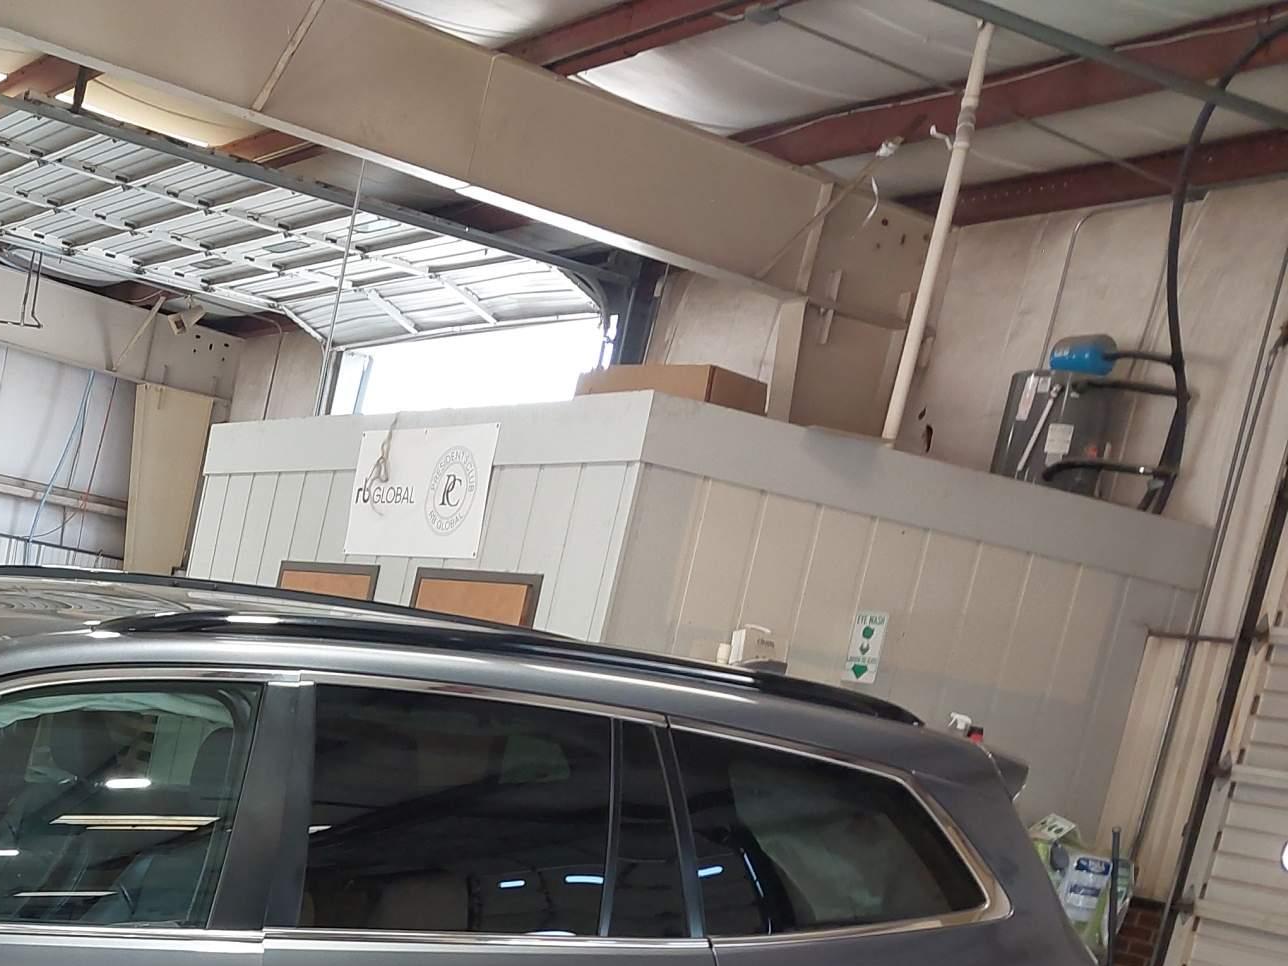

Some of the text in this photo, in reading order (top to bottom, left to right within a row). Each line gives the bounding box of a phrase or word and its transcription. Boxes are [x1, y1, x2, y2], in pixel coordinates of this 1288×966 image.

[372, 486, 415, 505] GLOBAL
[437, 512, 464, 531] GLOBAL
[869, 615, 886, 625] WASH
